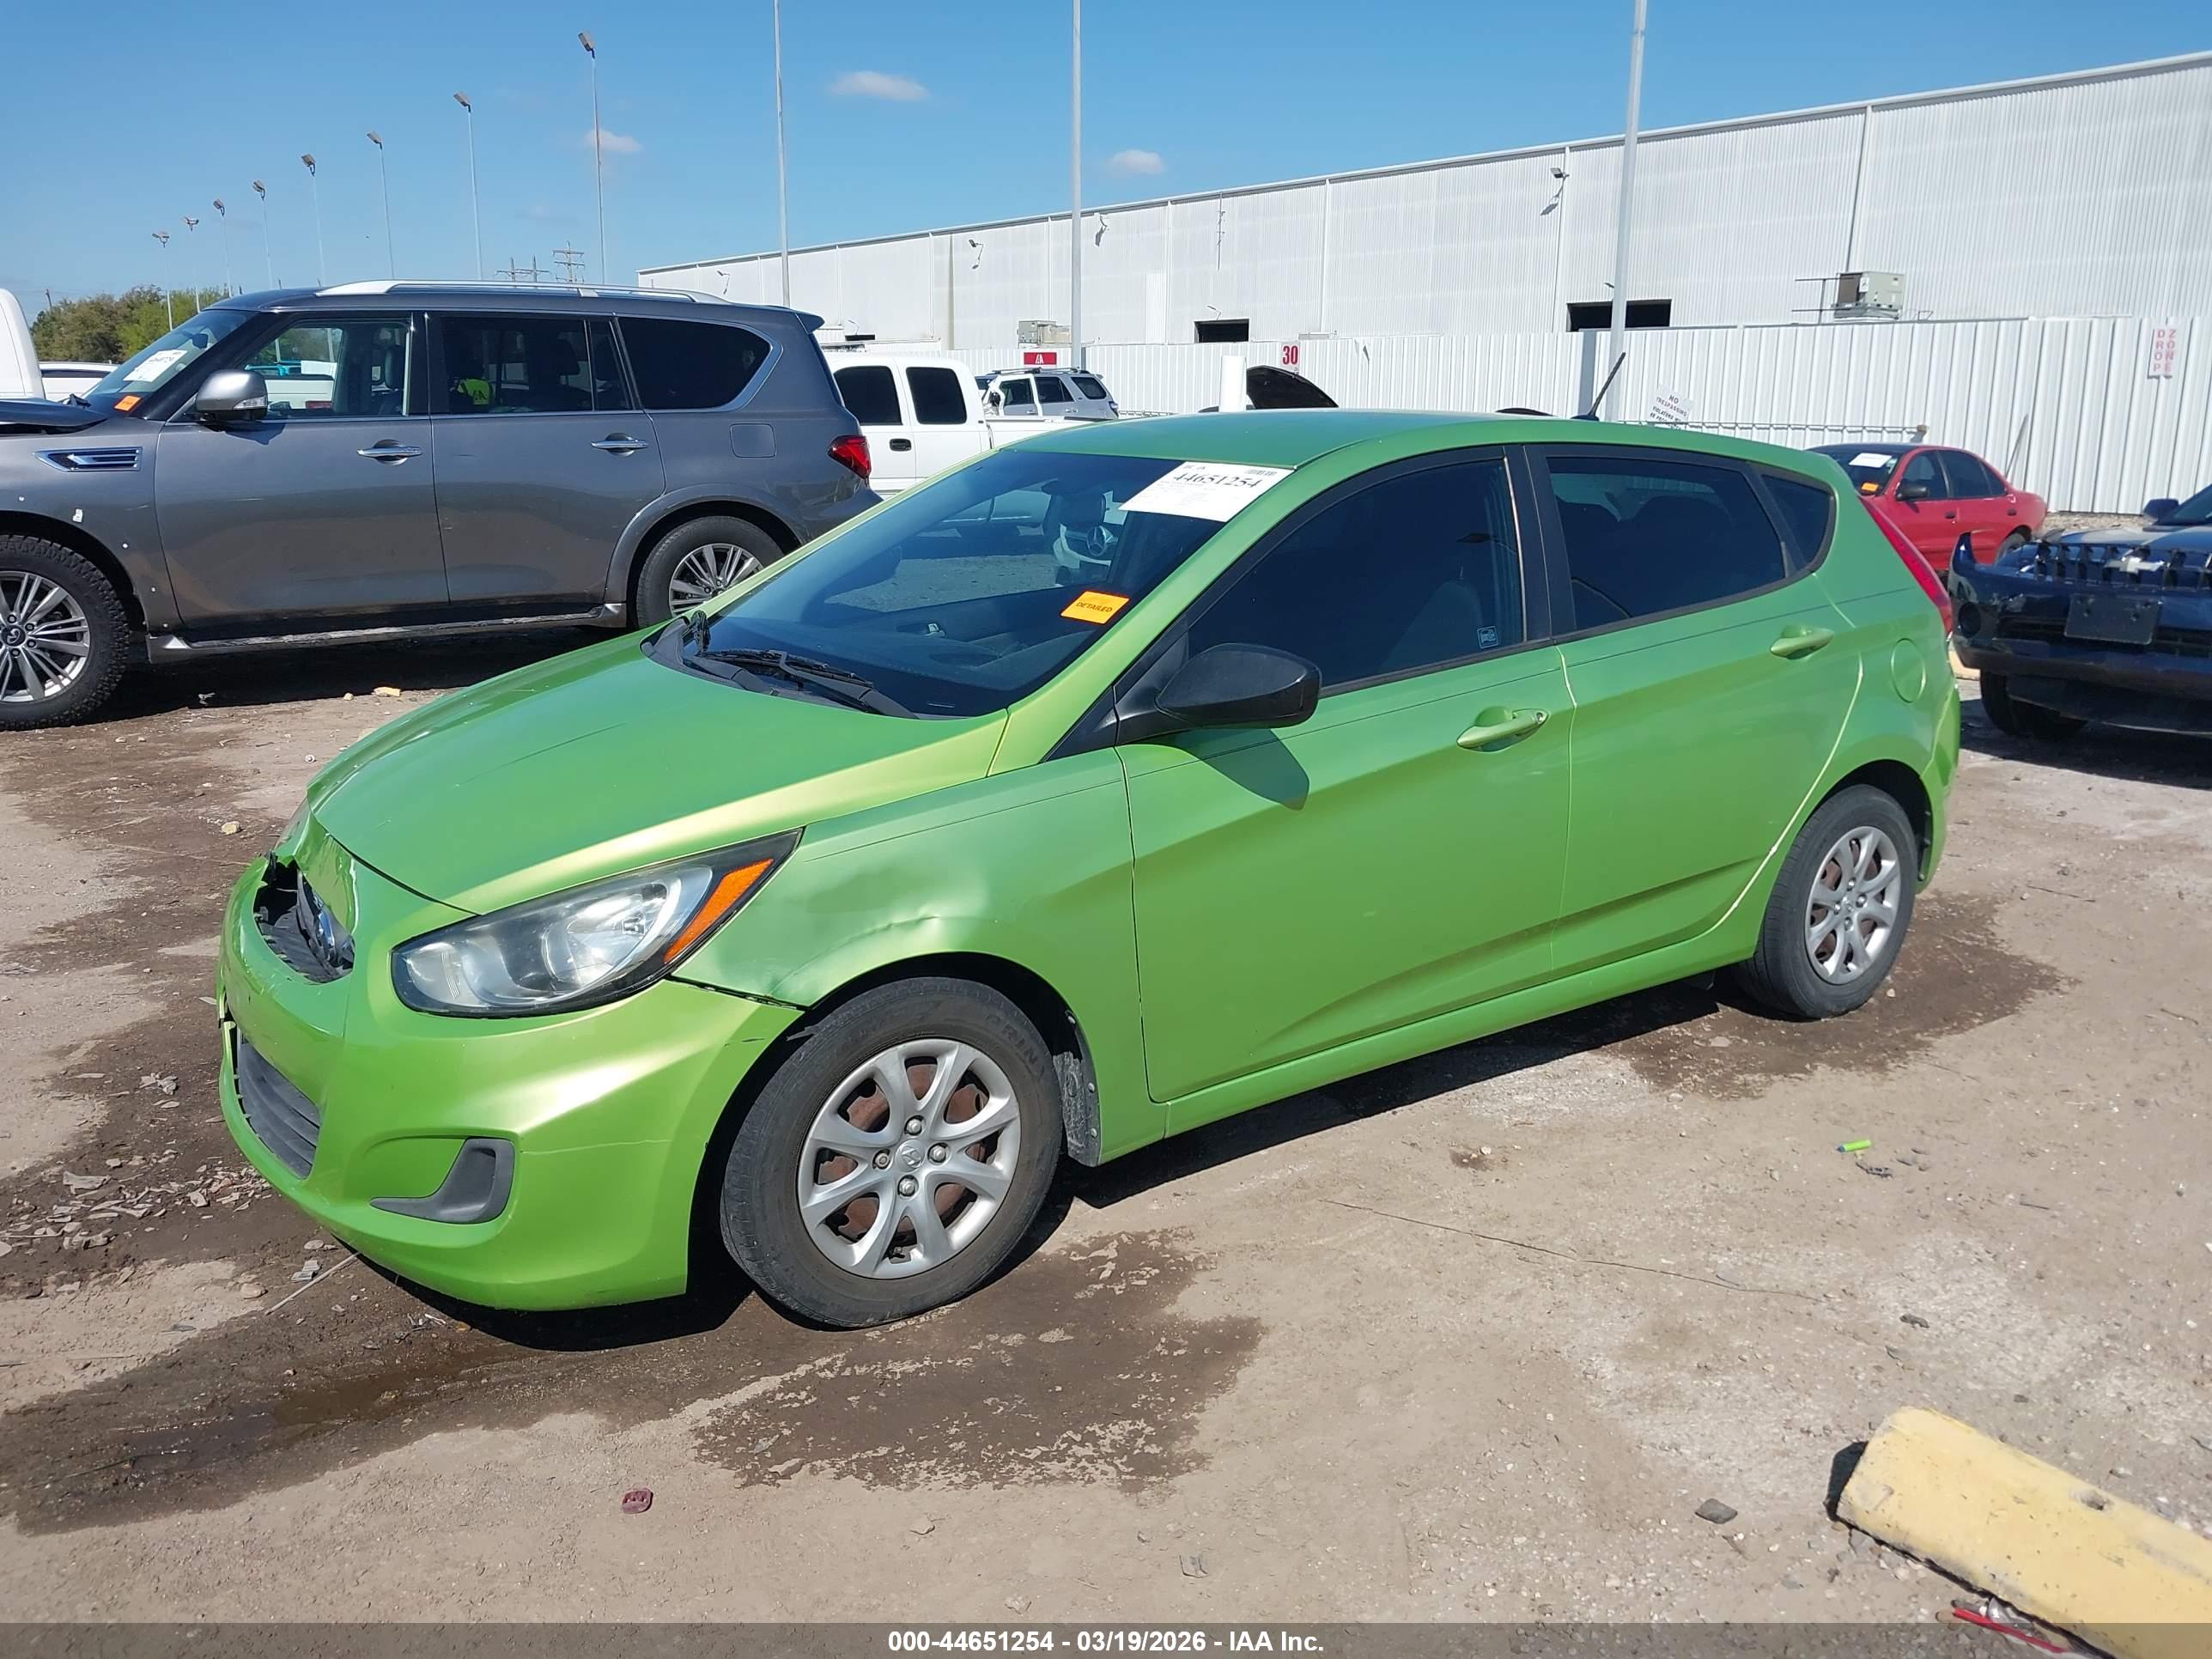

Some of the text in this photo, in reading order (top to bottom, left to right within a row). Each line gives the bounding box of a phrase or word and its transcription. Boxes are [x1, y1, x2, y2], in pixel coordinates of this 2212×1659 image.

[1282, 345, 1298, 365] 30
[2153, 329, 2166, 372] DROP
[1656, 397, 1687, 417] TRESPASSING
[1668, 394, 1680, 404] NO
[1652, 405, 1674, 420] VIOLATORS
[1173, 472, 1263, 488] 44651254
[1076, 601, 1113, 613] DETAILED
